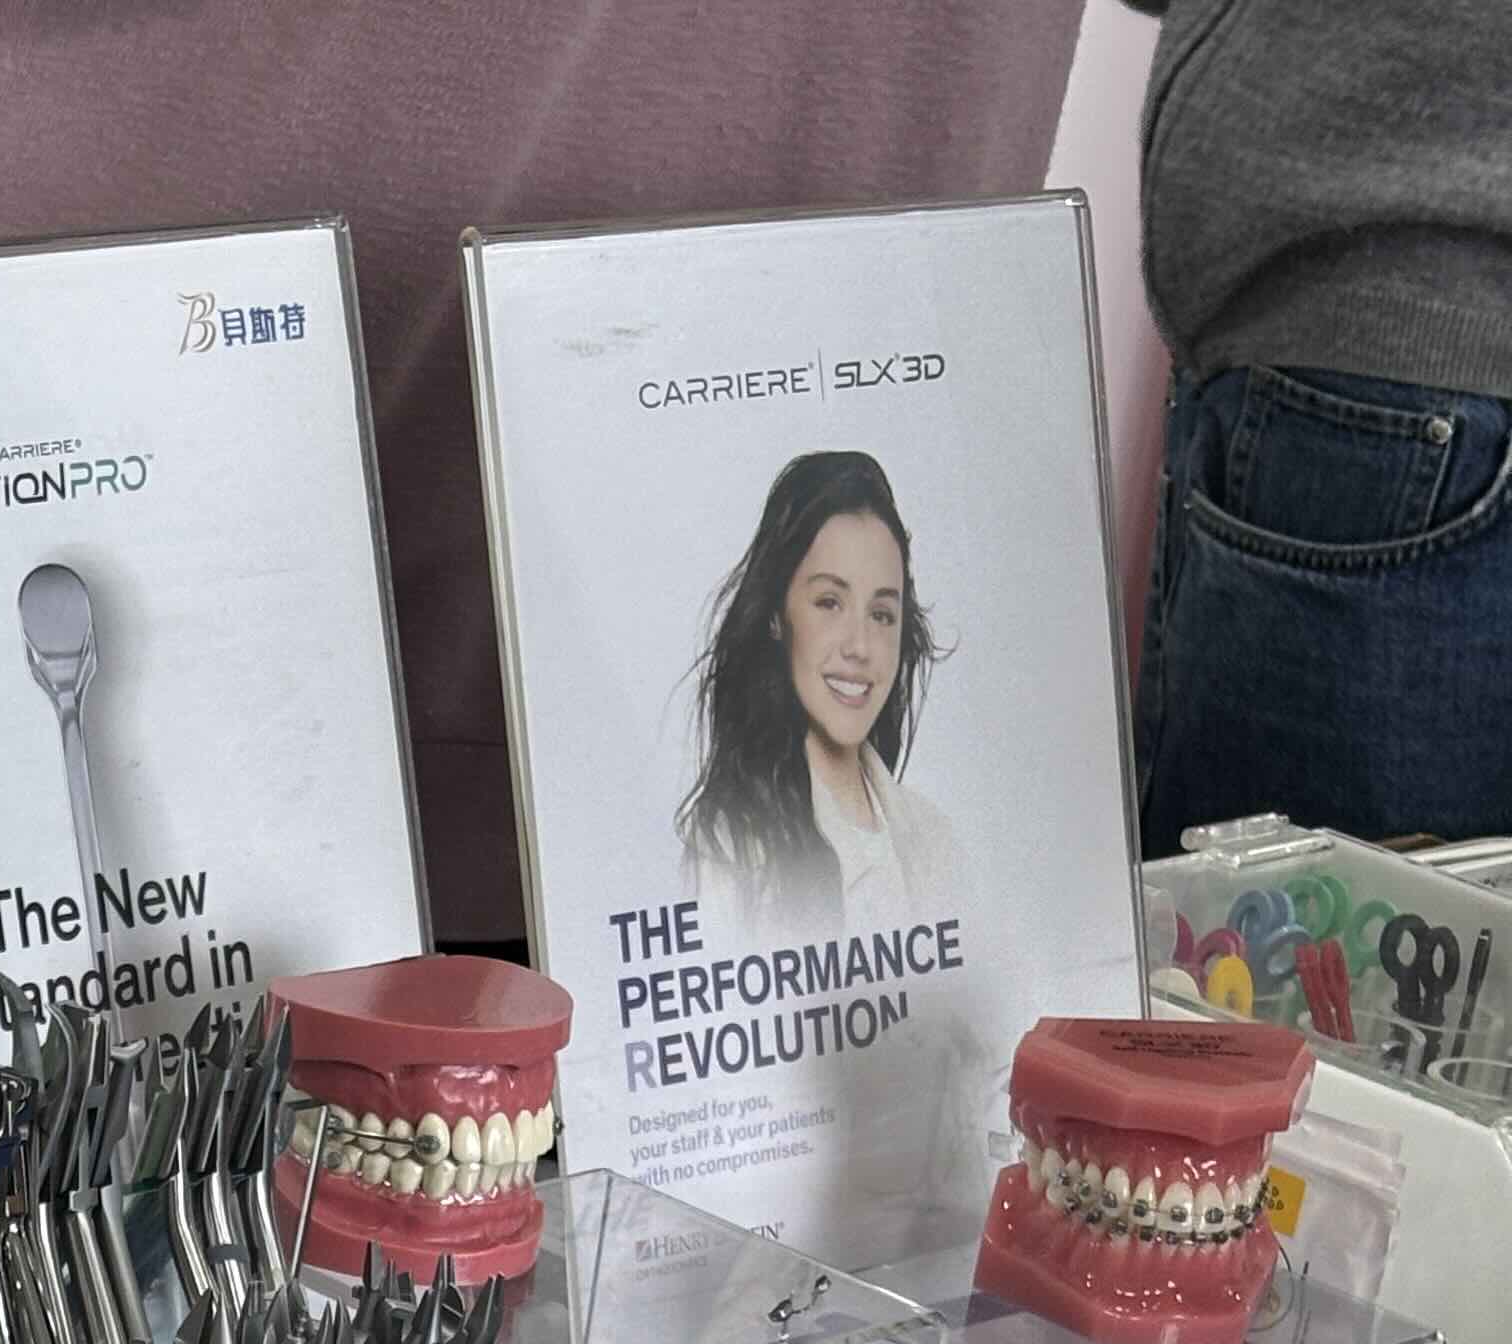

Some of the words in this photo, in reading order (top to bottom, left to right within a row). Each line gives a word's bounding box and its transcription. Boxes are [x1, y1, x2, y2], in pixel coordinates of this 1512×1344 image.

[218, 302, 306, 346] 貝斯特
[638, 365, 810, 409] CARRIERE
[94, 868, 207, 934] New
[609, 900, 703, 963] THE
[208, 929, 253, 989] in
[617, 919, 963, 1029] PERFORMANCE
[624, 991, 909, 1093] REVOLUTION
[629, 1103, 708, 1137] Designed
[712, 1098, 734, 1119] for
[629, 1140, 668, 1168] your
[671, 1128, 709, 1155] staff
[713, 1126, 726, 1145] &
[727, 1124, 764, 1147] your
[767, 1106, 837, 1138] patients
[673, 1161, 695, 1179] no
[697, 1140, 814, 1177] compromises.
